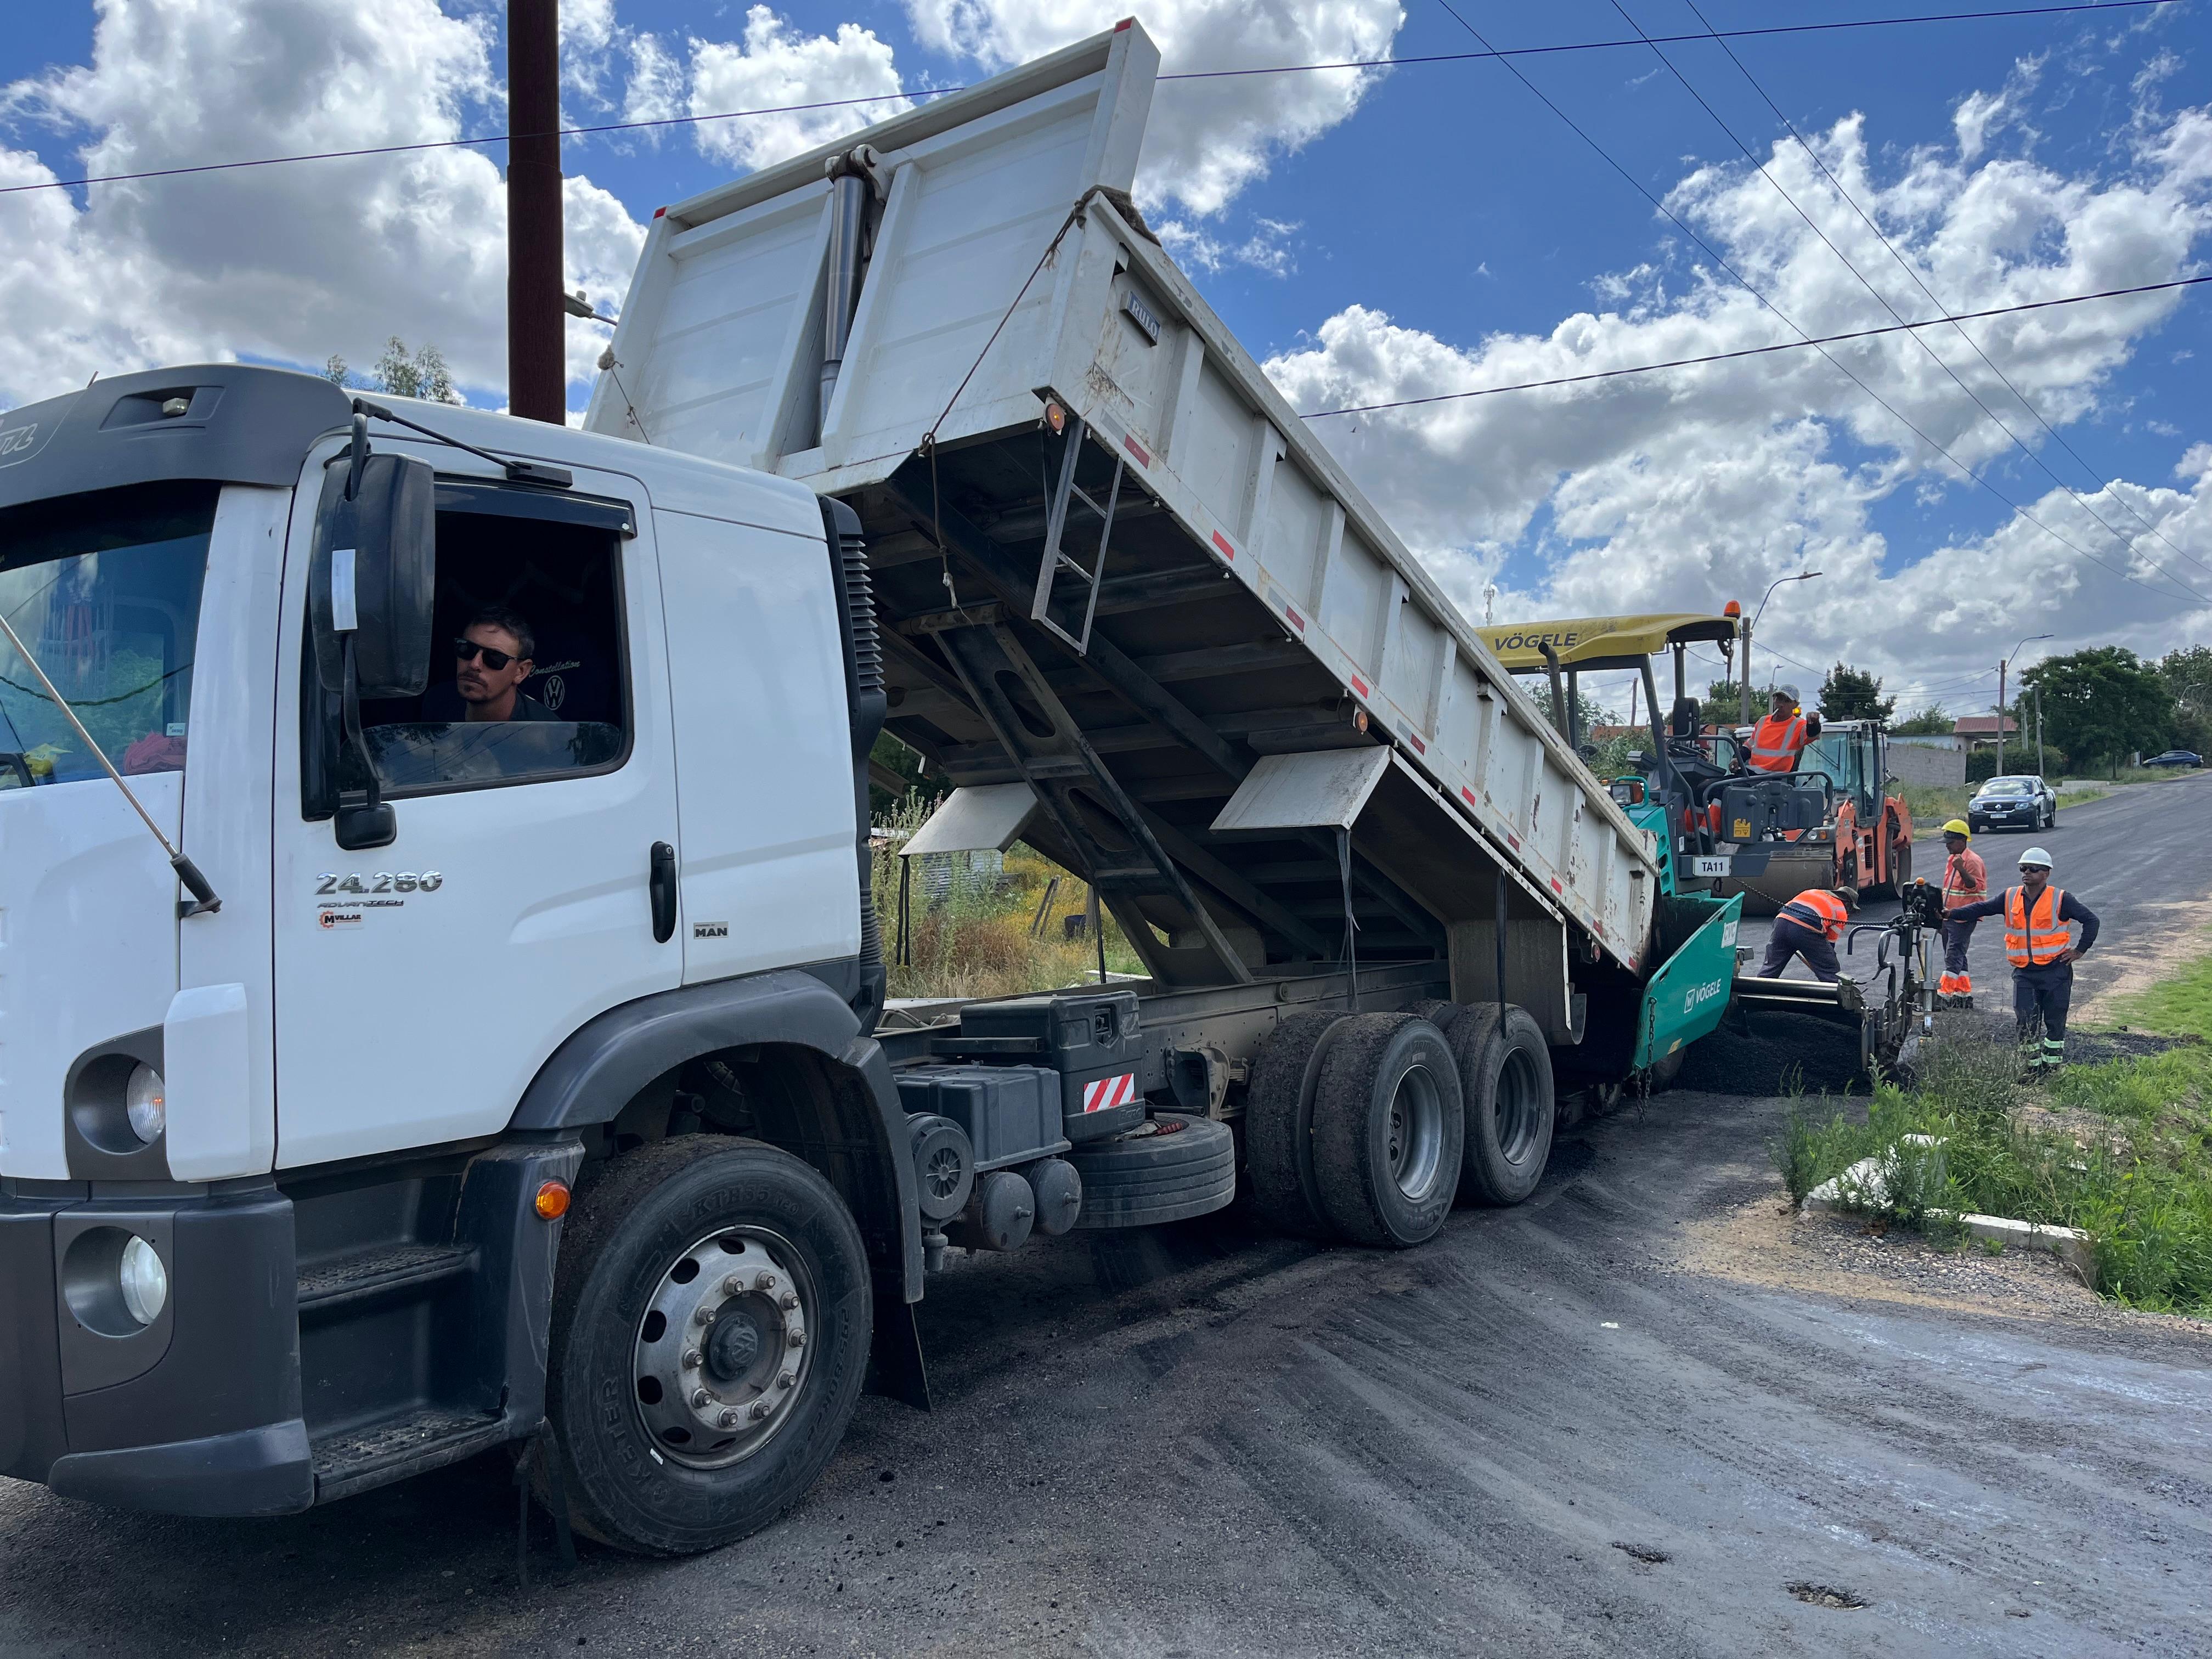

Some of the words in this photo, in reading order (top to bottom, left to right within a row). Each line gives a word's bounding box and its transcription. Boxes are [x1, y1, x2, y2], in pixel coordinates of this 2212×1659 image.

[1131, 299, 1158, 337] RULO
[1495, 633, 1578, 651] VÖGELE
[528, 660, 581, 678] Constellation
[1701, 862, 1723, 872] TA11
[314, 870, 443, 895] 24.280
[695, 928, 727, 937] MAN
[1696, 978, 1722, 1004] VÖGELE
